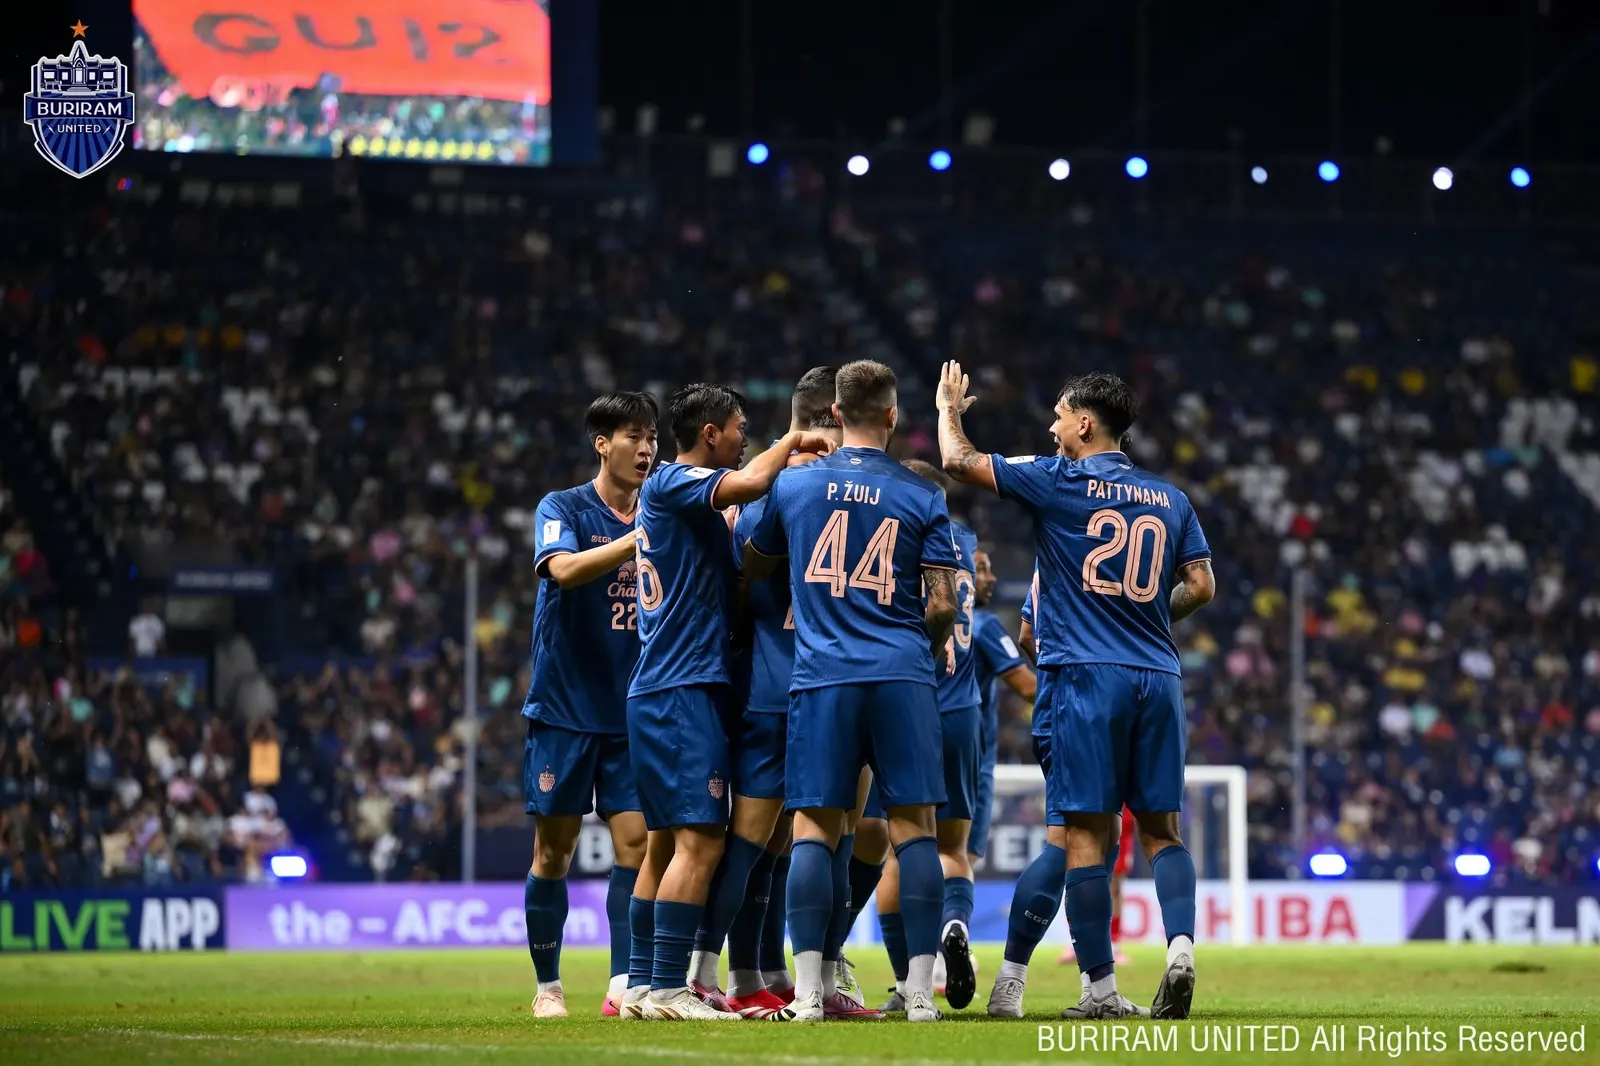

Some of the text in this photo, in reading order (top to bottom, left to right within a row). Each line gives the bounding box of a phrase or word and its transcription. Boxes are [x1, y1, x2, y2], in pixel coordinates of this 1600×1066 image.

[827, 480, 881, 506] P. ŽUIJ
[1086, 479, 1171, 509] PATTYNAMA
[804, 509, 900, 606] 44
[1082, 508, 1167, 603] 20
[607, 582, 637, 598] Cha
[611, 602, 637, 630] 22
[0, 897, 220, 950] LIVE APP
[268, 900, 353, 943] the
[393, 899, 598, 944] AFC.cm
[1118, 895, 1359, 941] OHIBA
